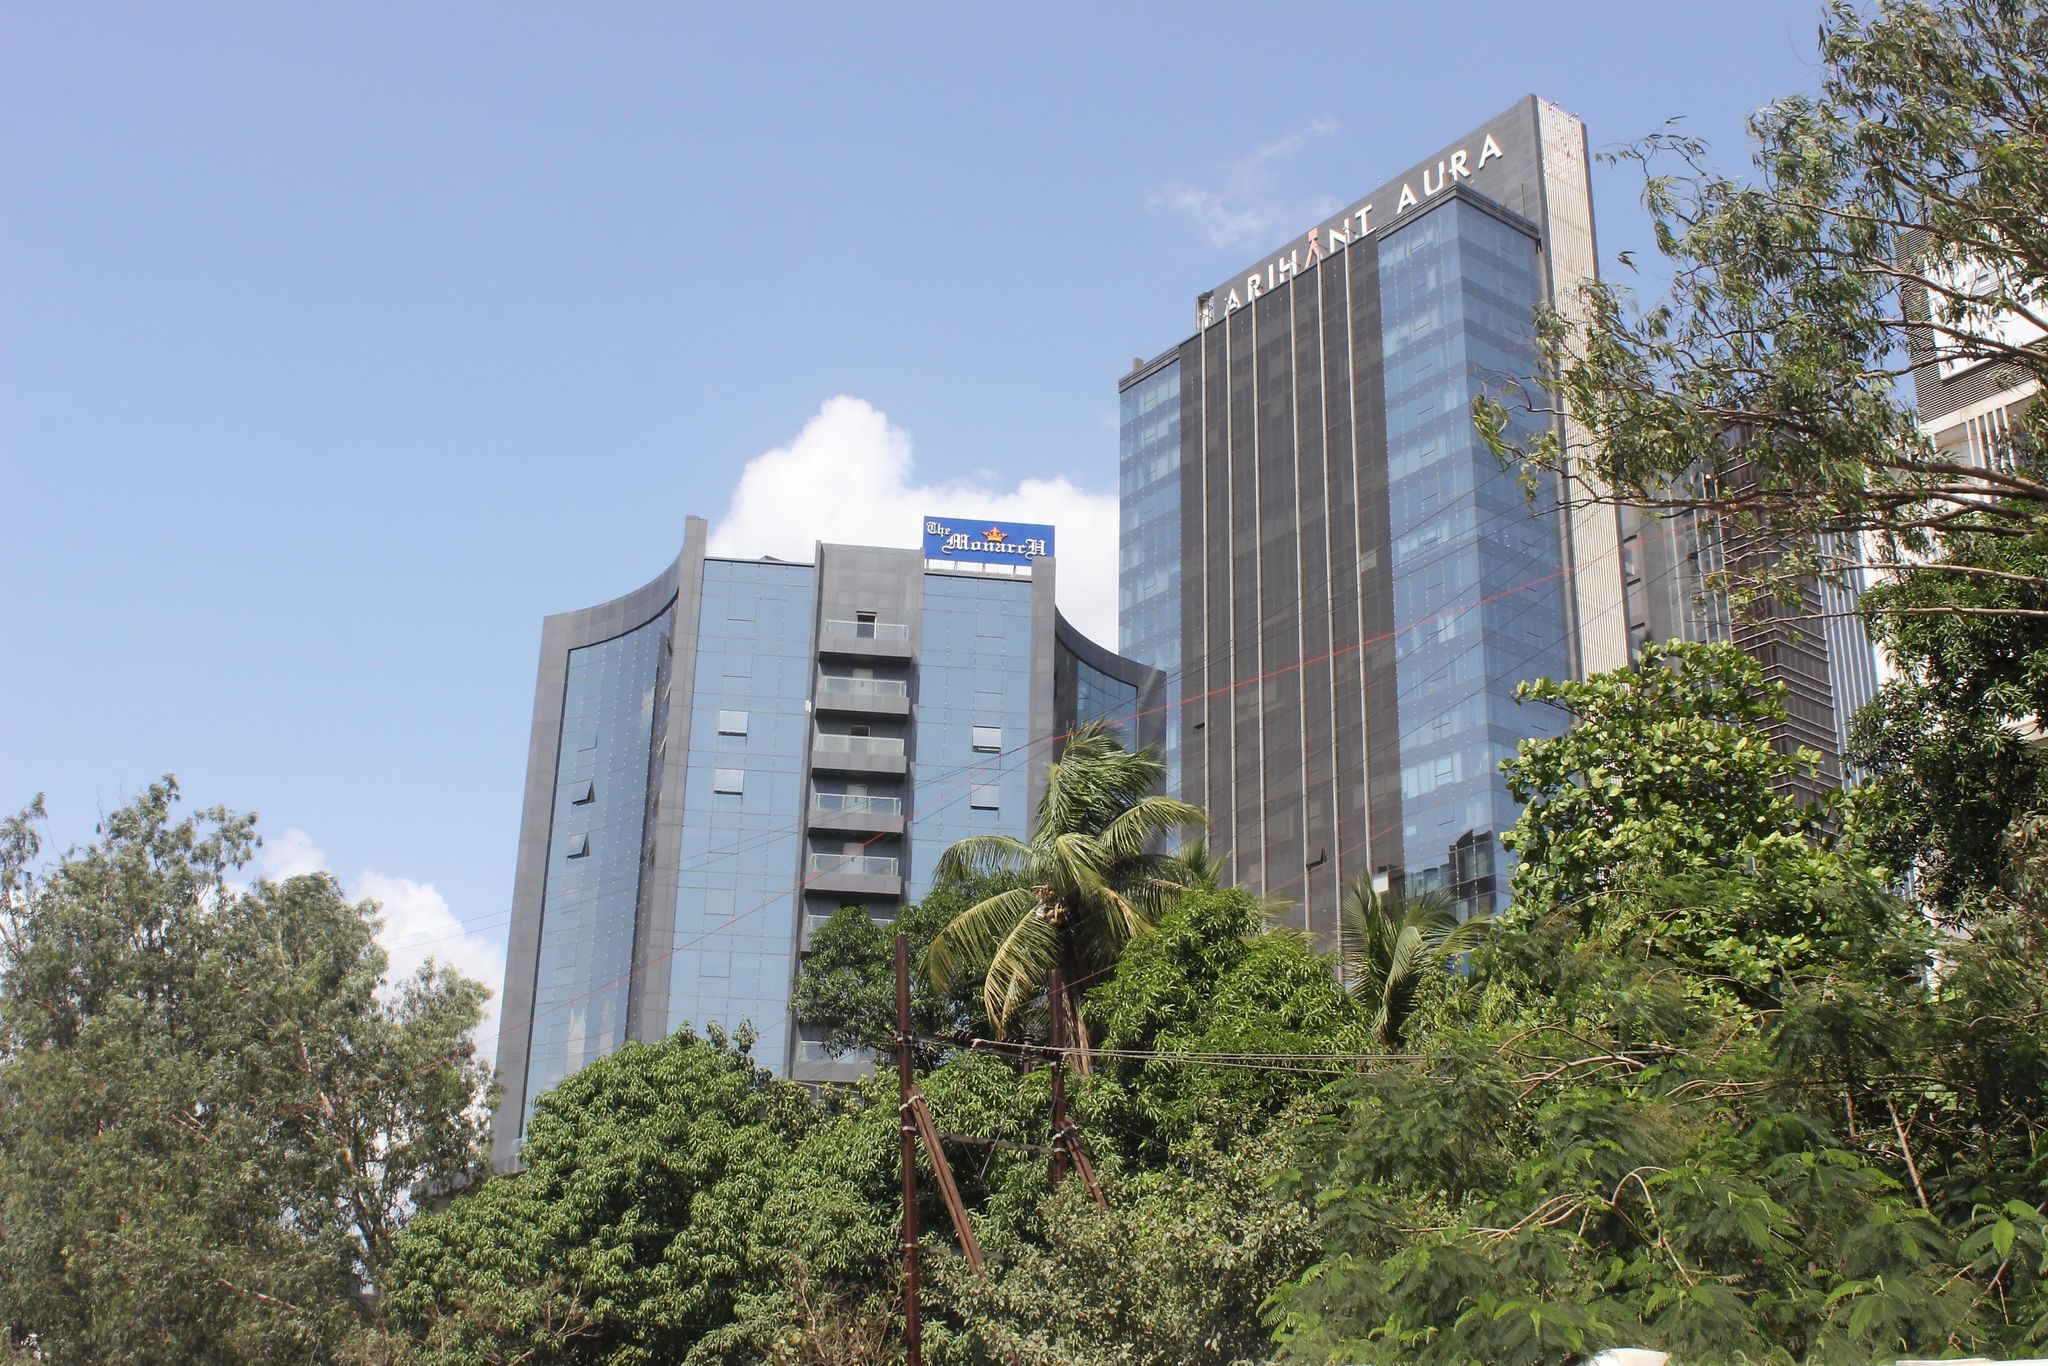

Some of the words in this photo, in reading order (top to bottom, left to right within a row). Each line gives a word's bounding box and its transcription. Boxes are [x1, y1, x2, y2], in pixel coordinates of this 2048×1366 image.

[1223, 203, 1373, 317] ARIHANT
[1396, 132, 1503, 215] AURA
[926, 521, 951, 537] The
